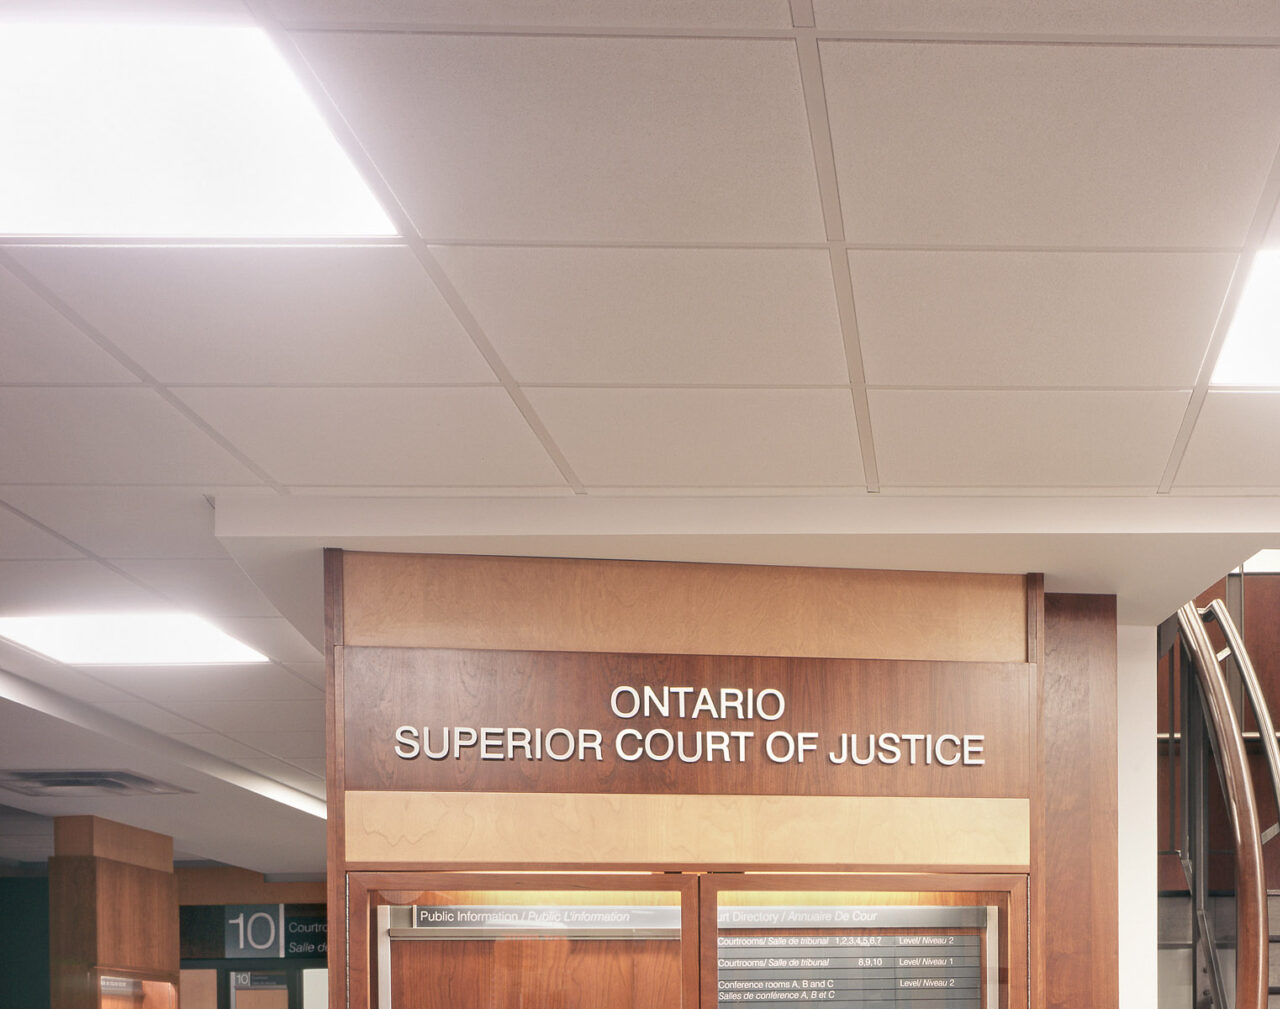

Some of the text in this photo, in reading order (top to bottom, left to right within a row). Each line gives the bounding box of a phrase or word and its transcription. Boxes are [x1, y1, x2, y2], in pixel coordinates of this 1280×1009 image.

[610, 685, 785, 721] ONTARIO
[394, 725, 985, 766] SUPERIOR COURT OF JUSTICE
[420, 910, 454, 922] Public
[457, 910, 519, 922] Information
[527, 910, 561, 923] Public
[563, 910, 630, 923] L'information
[733, 911, 778, 923] Directory
[787, 911, 832, 922] Annuaire
[834, 910, 850, 922] De
[852, 910, 877, 922] Cour
[228, 912, 276, 950] 10
[288, 922, 328, 933] Courtro
[288, 942, 315, 953] Salle
[717, 959, 767, 967] Courtrooms/
[788, 958, 799, 966] de
[800, 958, 829, 966] tribunal
[858, 958, 882, 967] 8,9,10
[236, 974, 249, 985] 10
